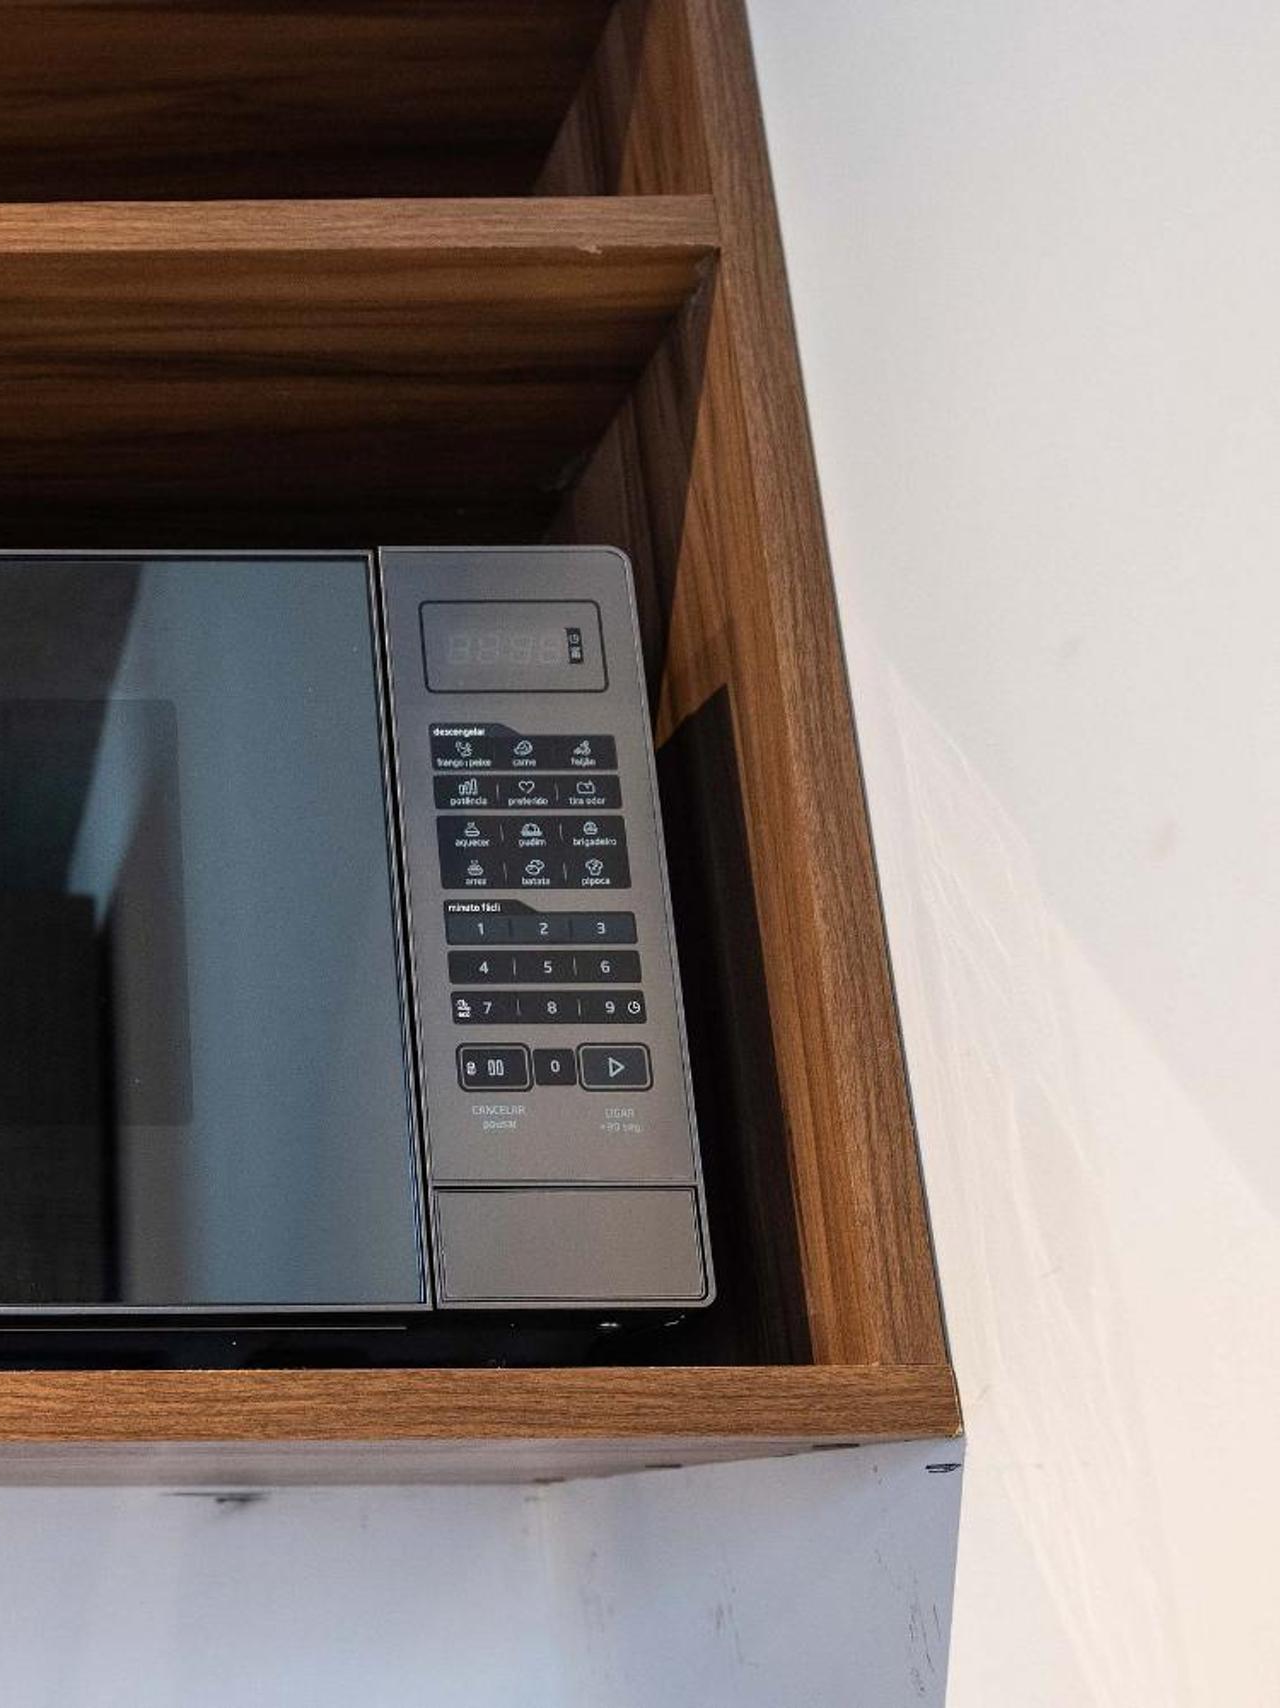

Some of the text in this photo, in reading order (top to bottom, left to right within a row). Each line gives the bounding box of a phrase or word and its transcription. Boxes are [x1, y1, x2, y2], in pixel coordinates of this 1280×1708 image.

[433, 728, 486, 737] descongelar
[512, 759, 537, 767] carne
[508, 796, 548, 806] preferido
[455, 839, 490, 848] aquecer
[573, 837, 617, 847] brigadeiro
[521, 877, 551, 885] batata
[581, 877, 610, 887] pipoca
[448, 903, 480, 912] minuto
[477, 922, 485, 936] 1
[539, 922, 549, 935] 2
[596, 922, 606, 935] 3
[479, 961, 489, 974] 4
[543, 960, 553, 974] 5
[600, 960, 610, 973] 6
[482, 1001, 493, 1014] 7
[546, 1001, 557, 1014] 8
[605, 1000, 616, 1014] 9
[550, 1059, 561, 1073] 0
[472, 1105, 526, 1115] CANCELAR
[604, 1108, 635, 1118] LIGAR
